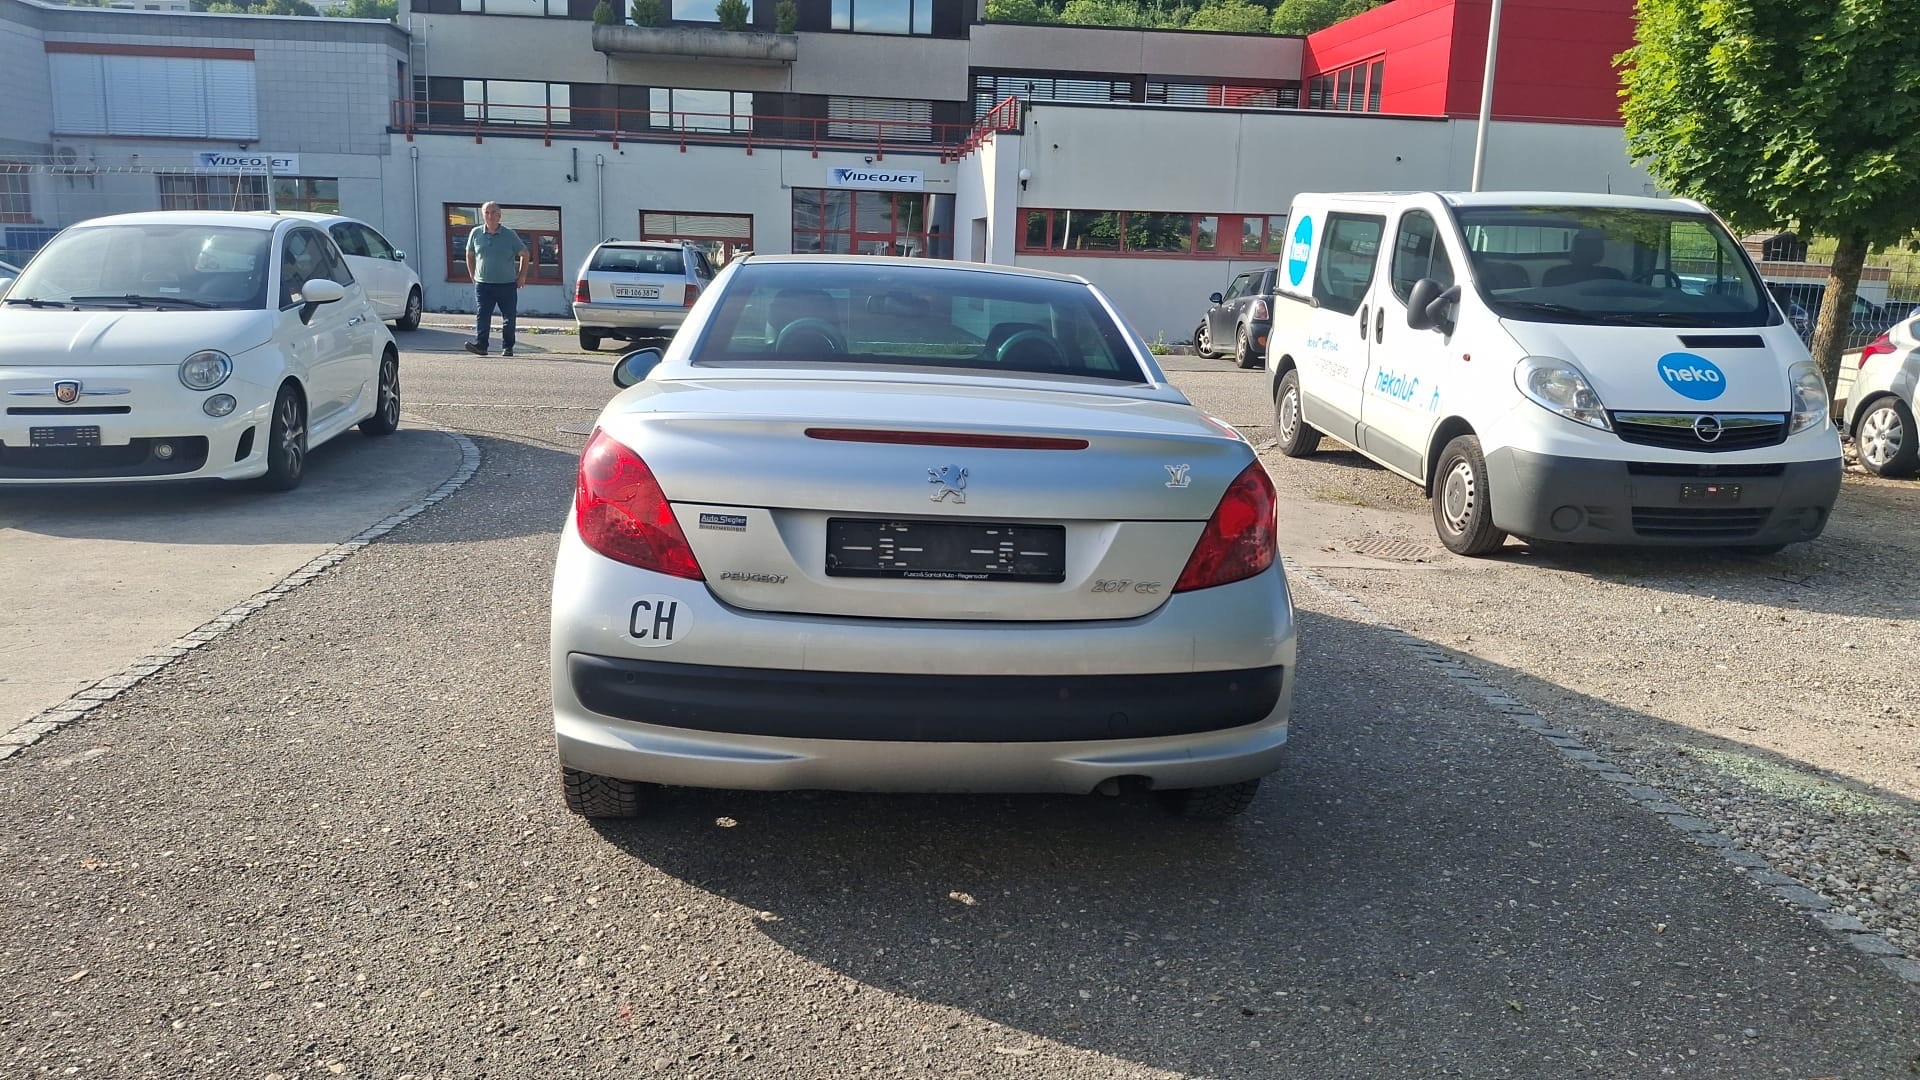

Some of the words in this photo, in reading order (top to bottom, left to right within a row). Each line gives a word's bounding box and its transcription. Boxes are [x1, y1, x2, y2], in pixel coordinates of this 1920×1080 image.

[207, 157, 293, 168] VIDEOET
[842, 170, 918, 183] VIDEOJET
[1662, 365, 1720, 382] heko
[701, 514, 719, 523] Auto
[720, 571, 788, 584] PEUGEOT
[1091, 580, 1131, 593] 207
[1134, 582, 1161, 594] CC
[629, 600, 677, 640] CH
